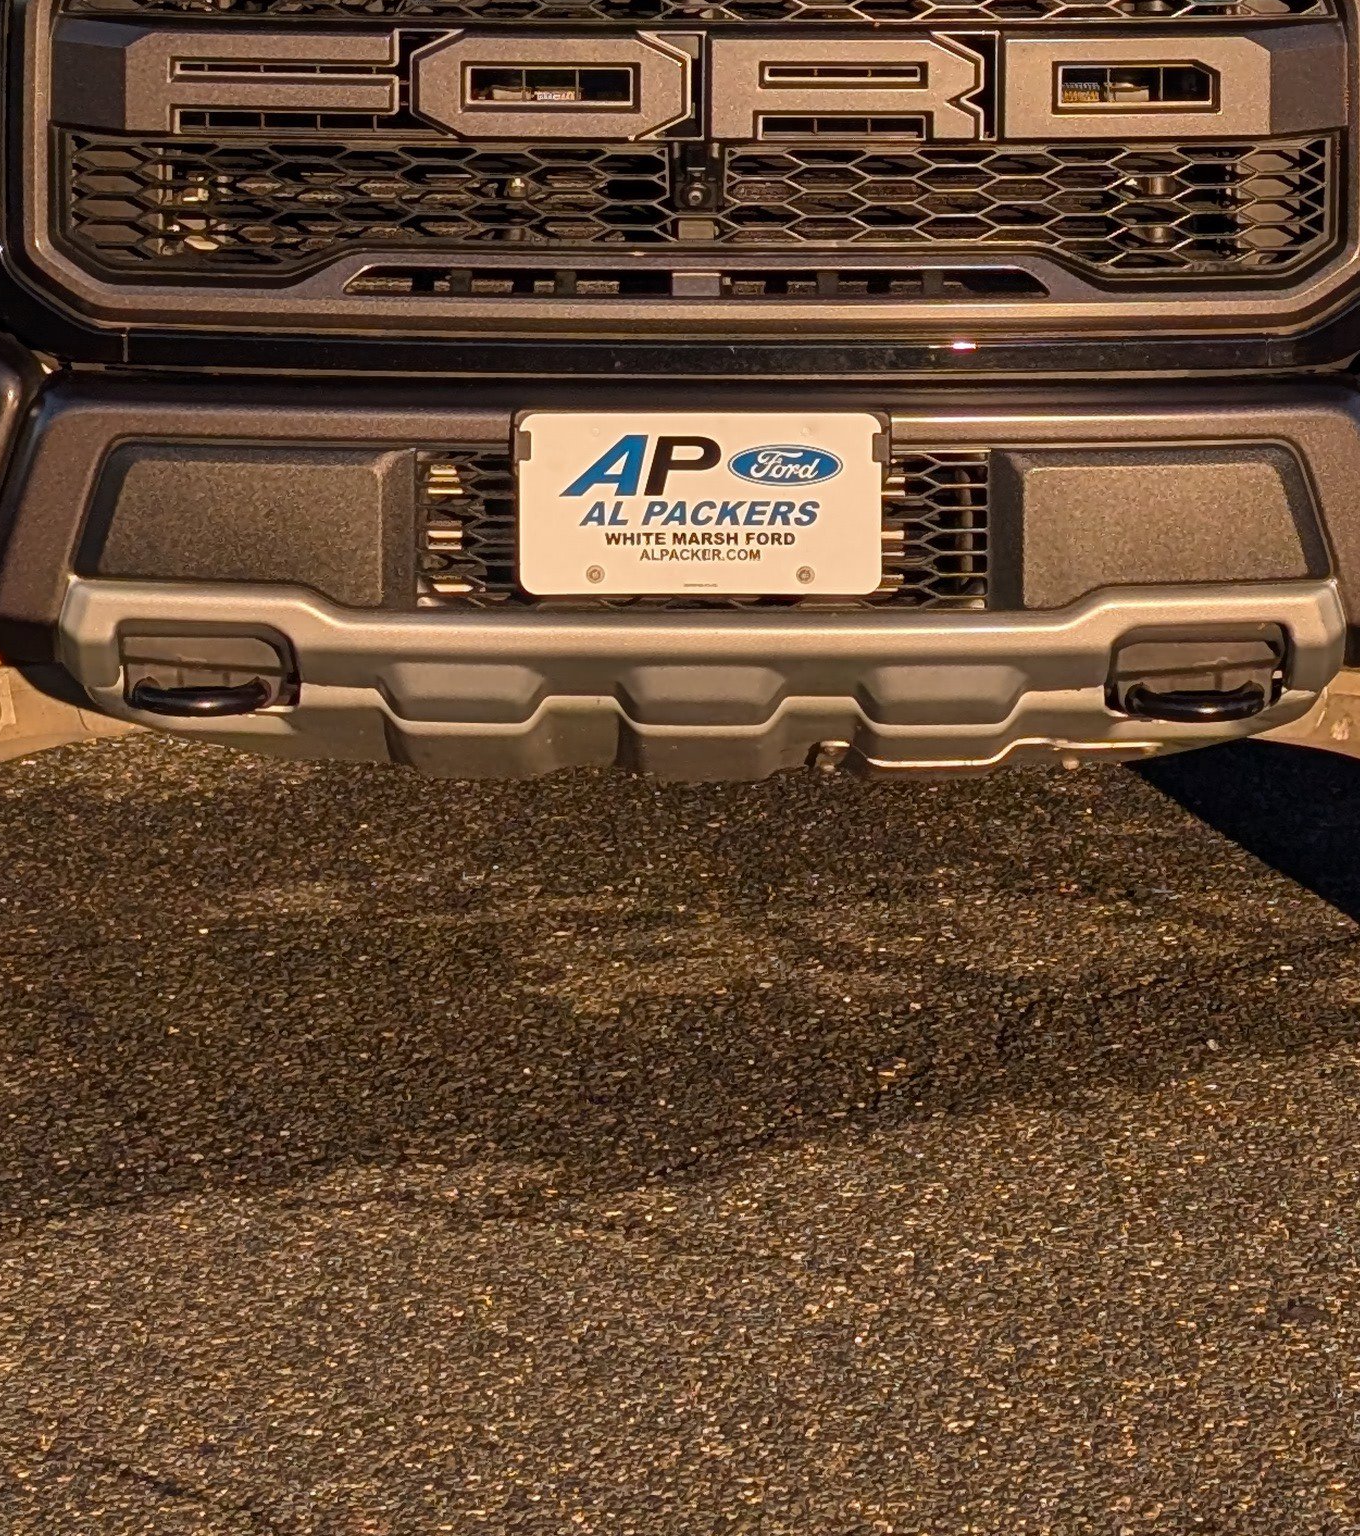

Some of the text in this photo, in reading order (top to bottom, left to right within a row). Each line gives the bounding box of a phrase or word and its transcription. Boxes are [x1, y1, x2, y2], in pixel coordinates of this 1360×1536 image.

[124, 28, 1272, 141] FORD
[559, 434, 722, 497] AP
[749, 450, 820, 480] Ford
[579, 500, 820, 527] AL PACKERS
[604, 532, 796, 546] WHITE MARSH FORD
[639, 548, 761, 562] ALPACKER.COM
